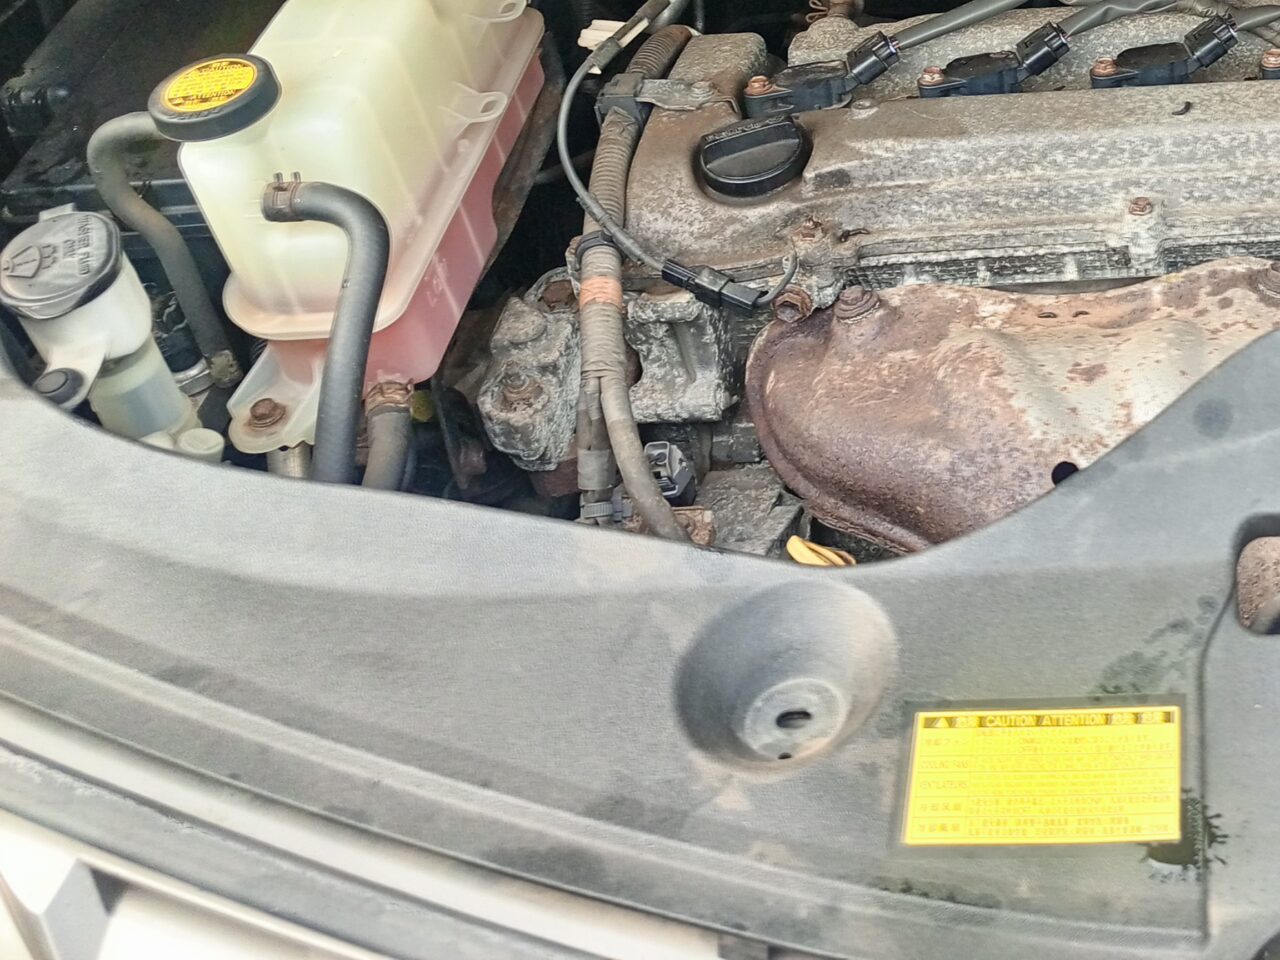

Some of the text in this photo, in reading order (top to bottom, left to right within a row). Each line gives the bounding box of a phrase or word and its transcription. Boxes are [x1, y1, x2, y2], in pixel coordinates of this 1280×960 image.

[78, 214, 92, 275] WASHER FLUID
[985, 714, 1036, 728] CAUTION
[1042, 712, 1105, 727] ATTENTION
